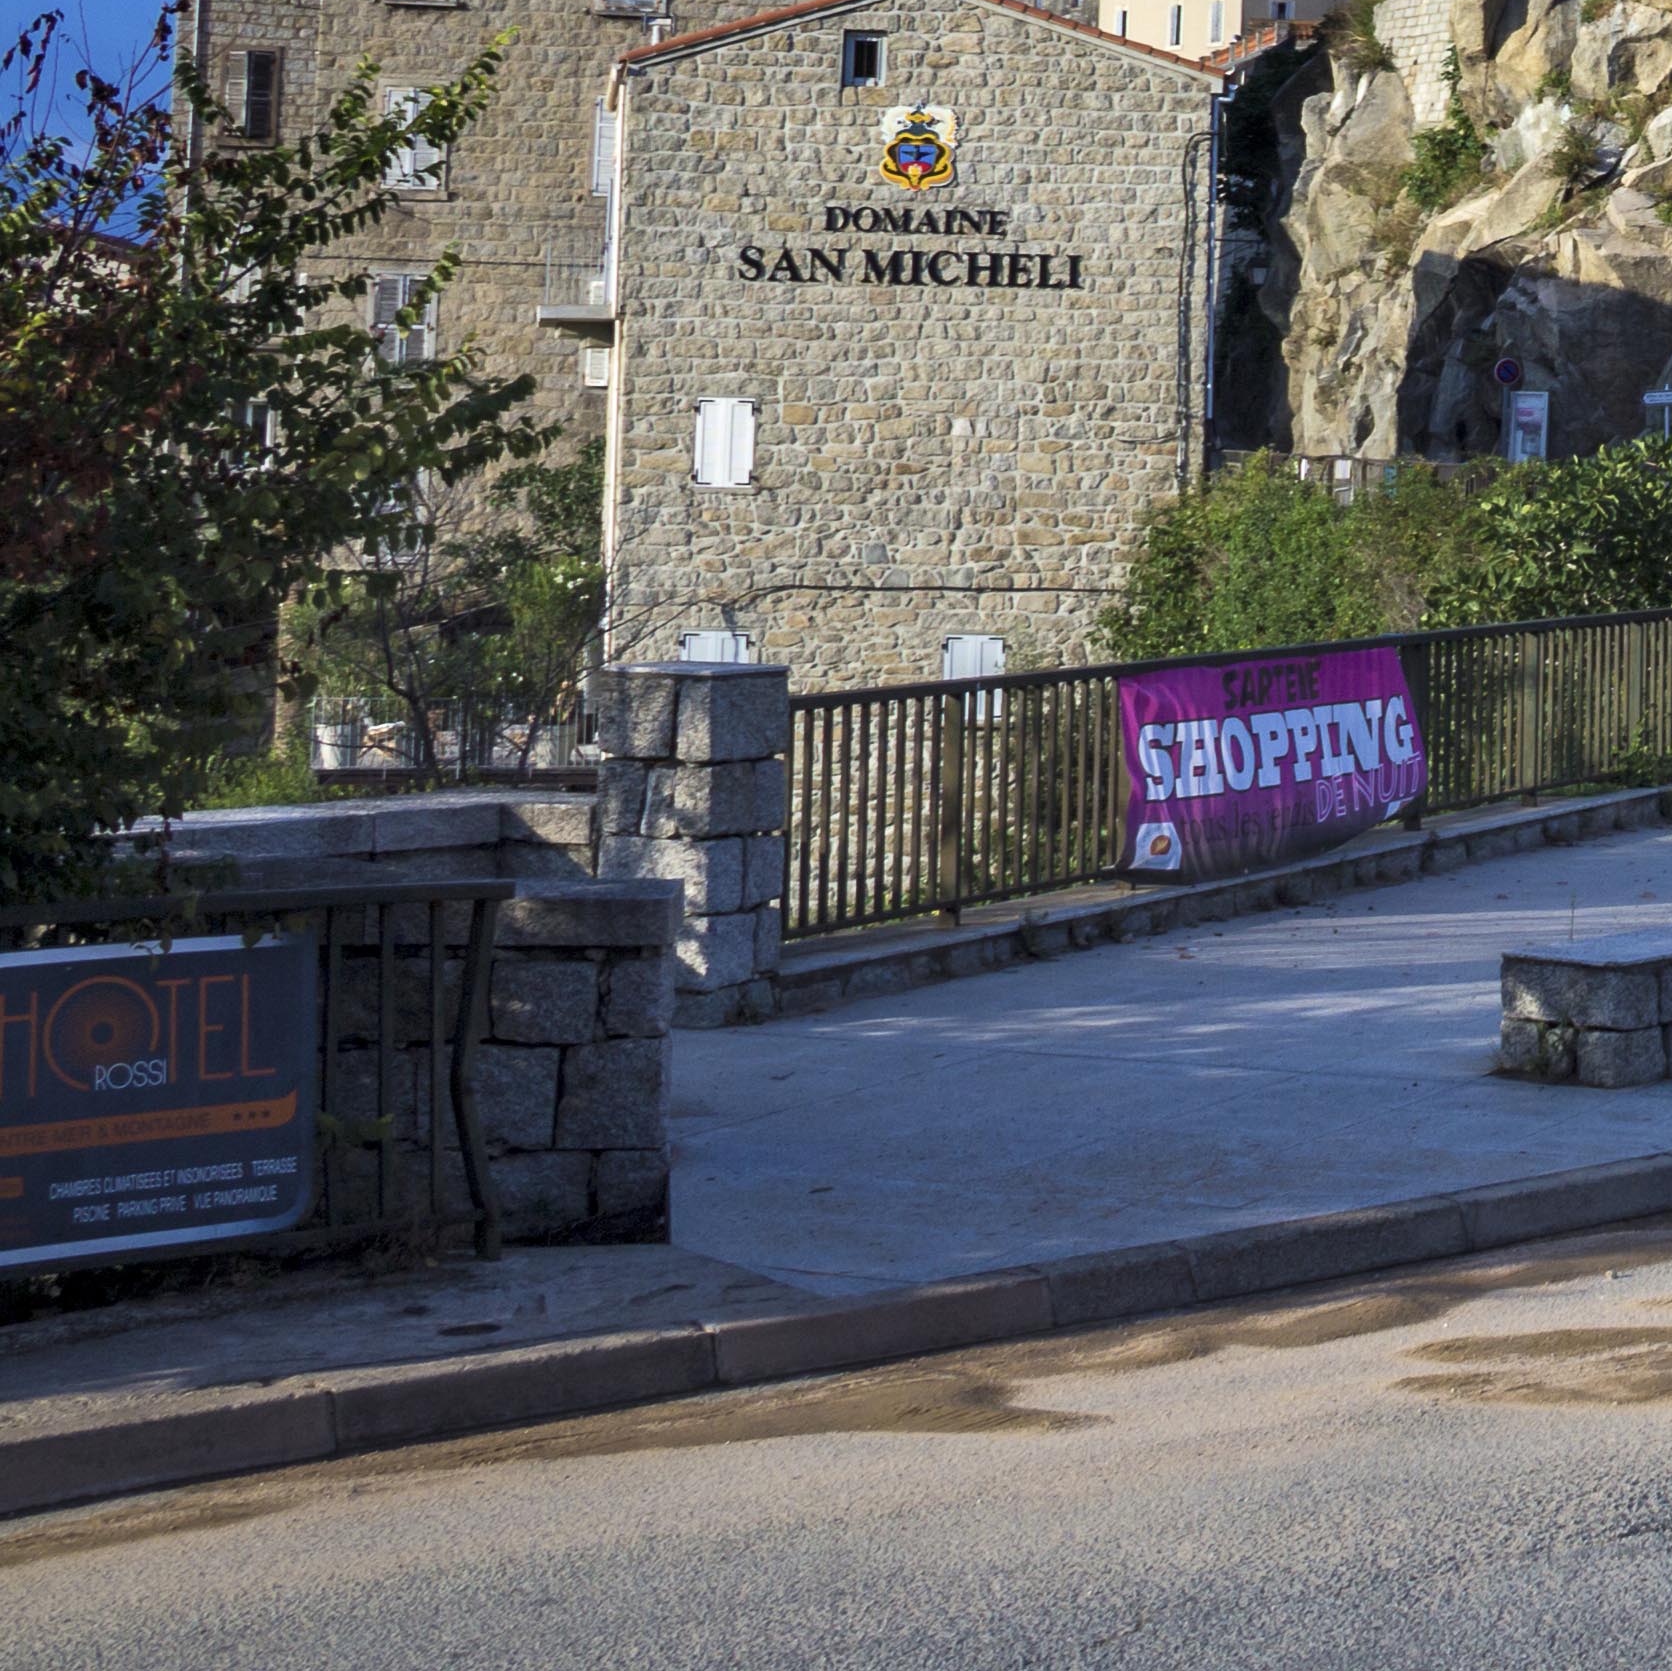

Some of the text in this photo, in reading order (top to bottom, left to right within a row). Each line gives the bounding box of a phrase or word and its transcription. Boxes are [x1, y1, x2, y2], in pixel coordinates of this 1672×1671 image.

[824, 206, 1009, 236] DOMAINE
[738, 246, 1084, 289] SAN MICHELI
[1138, 694, 1415, 803] SHOPPING
[1316, 751, 1421, 824] DE NUIT
[0, 974, 277, 1098] HOTEL
[95, 1058, 168, 1092] ROSSI
